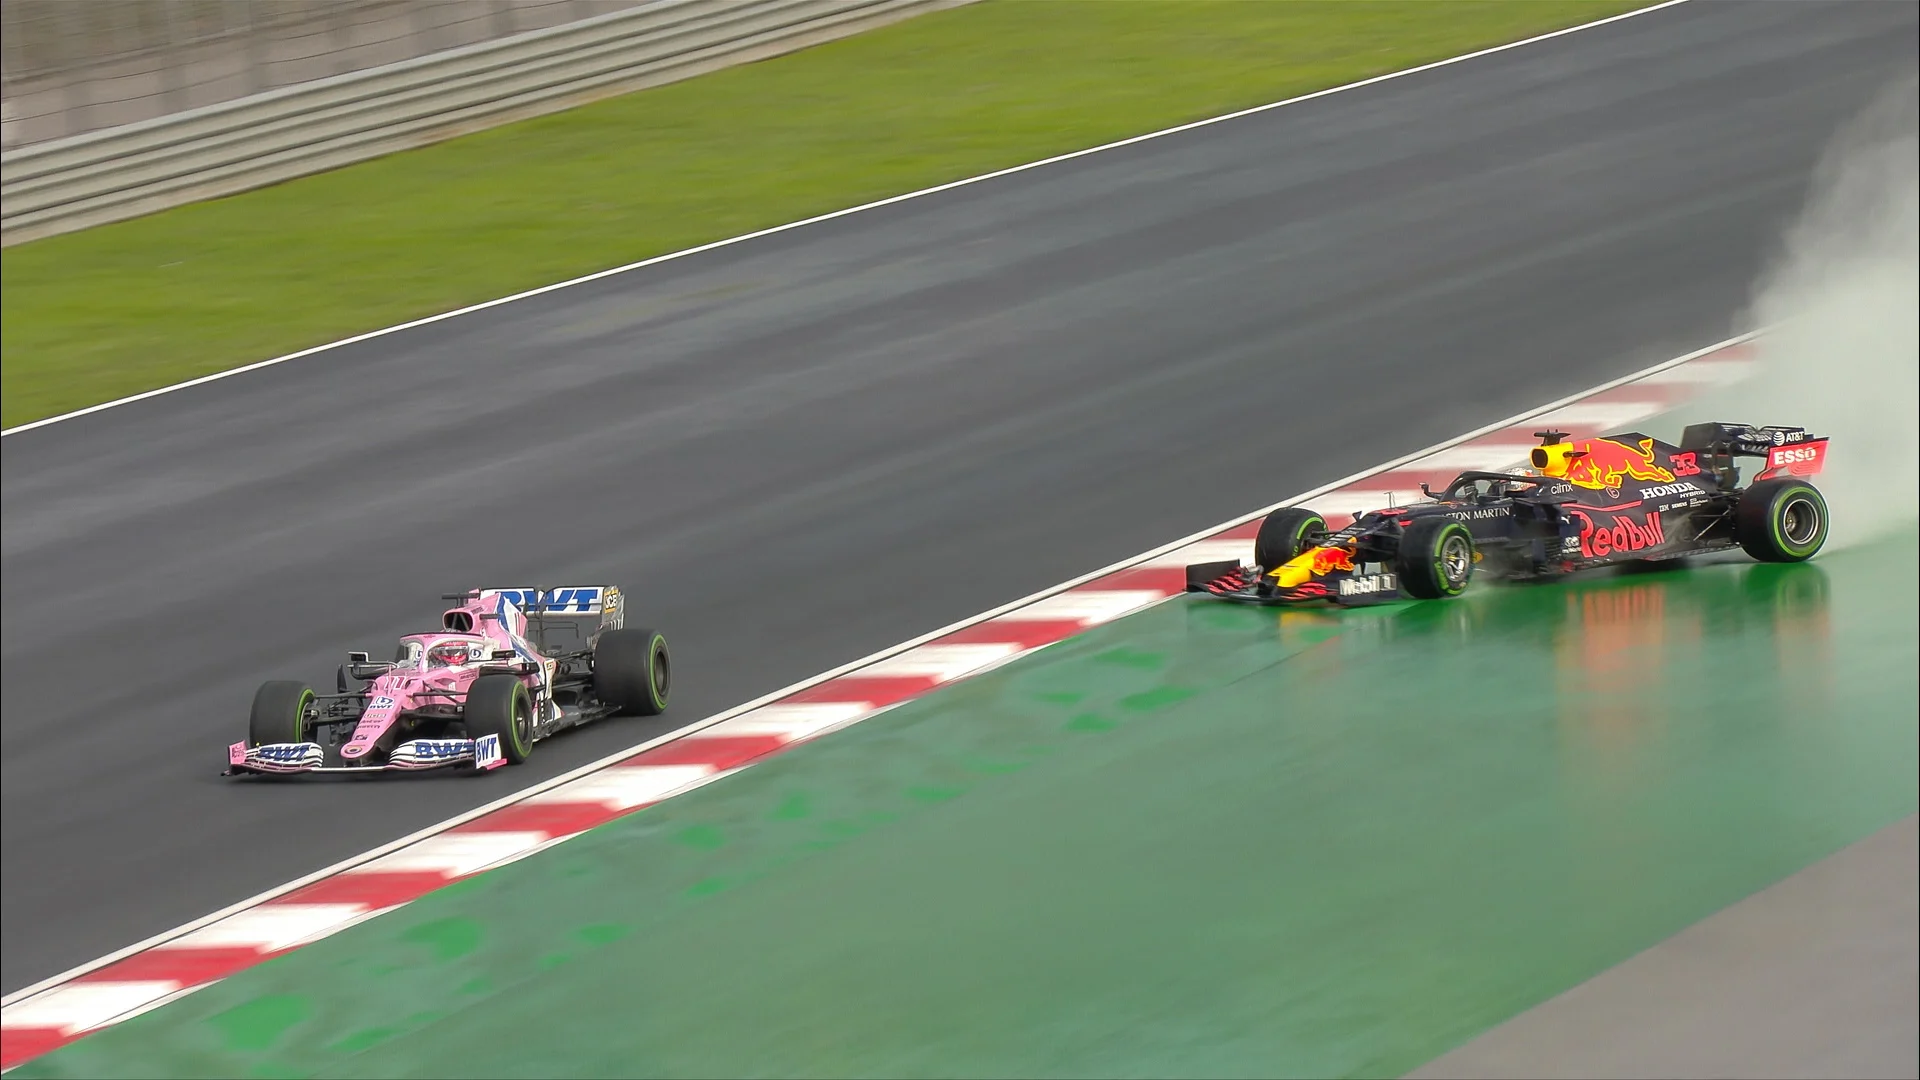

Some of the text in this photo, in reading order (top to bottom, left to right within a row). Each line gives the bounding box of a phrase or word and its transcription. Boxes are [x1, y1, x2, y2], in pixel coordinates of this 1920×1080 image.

[1786, 431, 1805, 443] AT&T
[1669, 452, 1701, 477] 33
[1774, 447, 1816, 465] ESSO
[1639, 482, 1700, 500] HONDA
[1680, 490, 1706, 499] HYBRID
[1473, 507, 1510, 520] MARTIN
[1339, 574, 1380, 596] Mobil
[384, 676, 406, 690] 11
[255, 744, 311, 762] BWT
[476, 737, 497, 762] BWT
